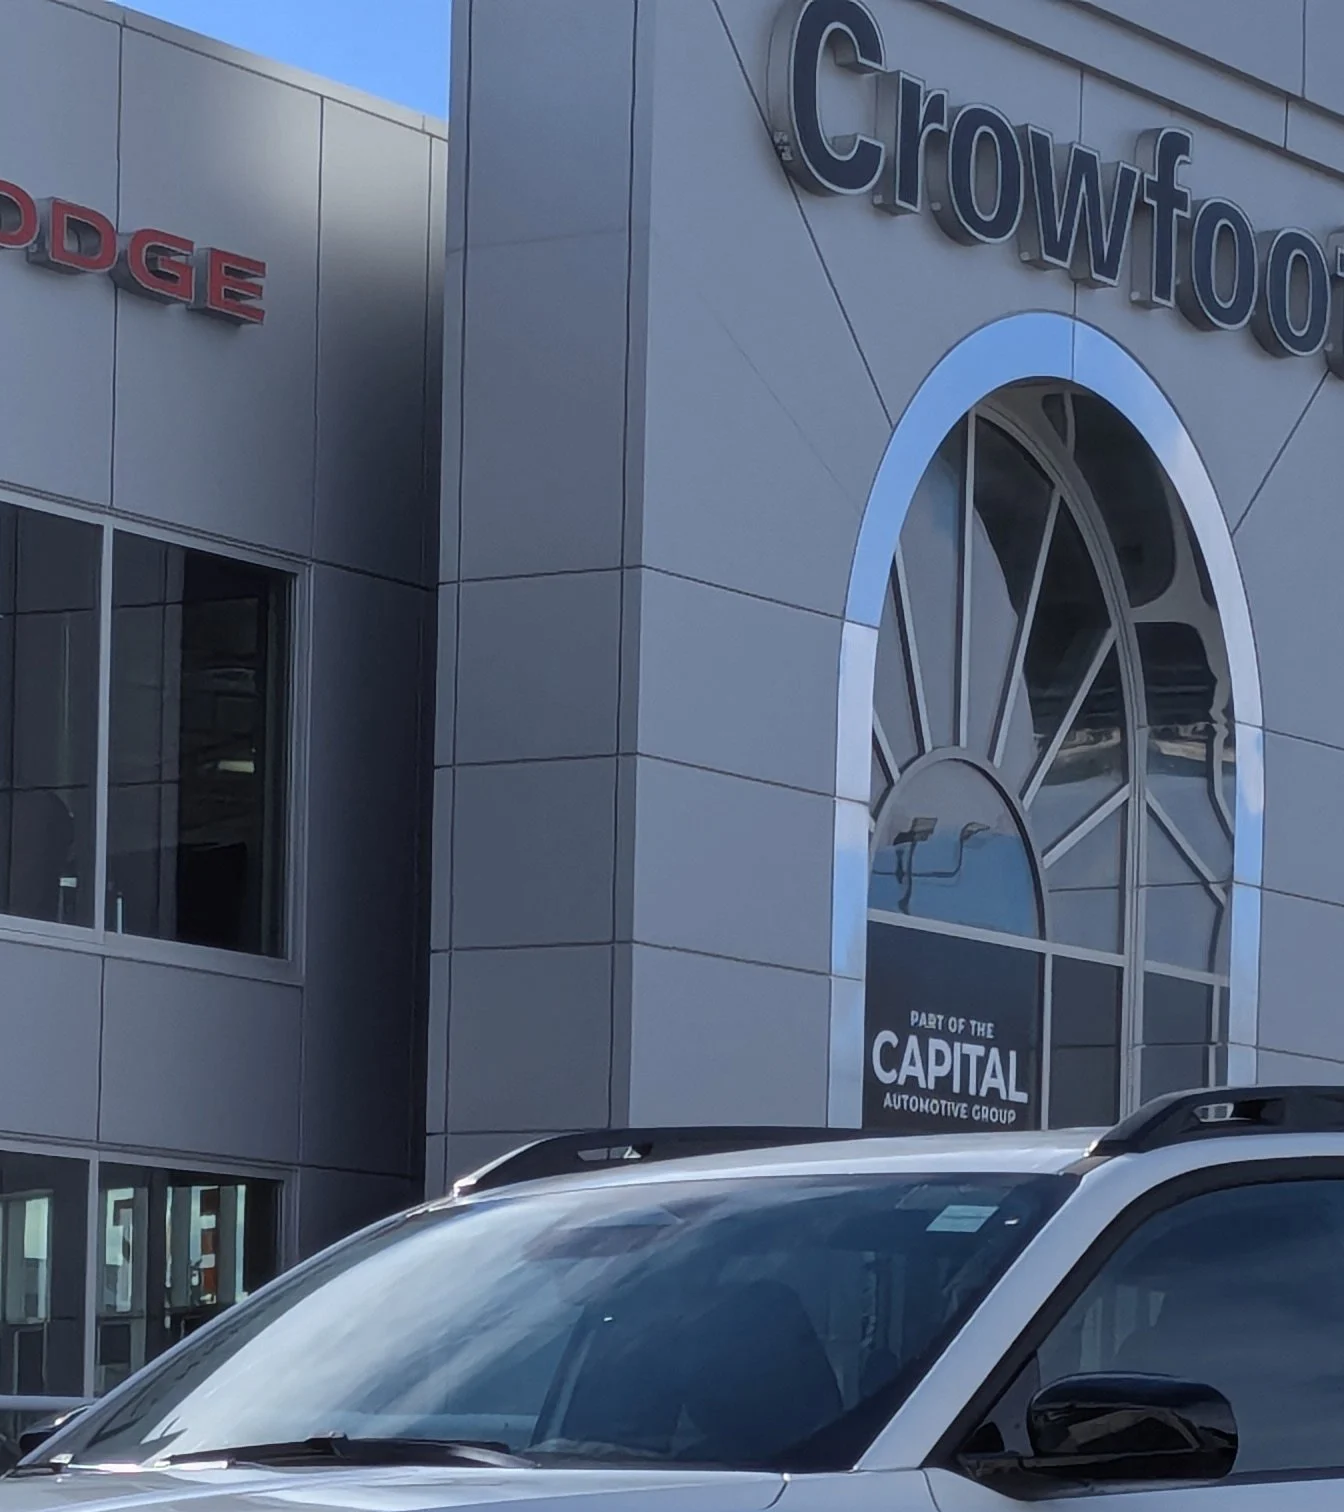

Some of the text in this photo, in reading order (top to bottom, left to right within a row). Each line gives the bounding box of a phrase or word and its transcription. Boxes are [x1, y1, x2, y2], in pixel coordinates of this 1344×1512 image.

[910, 1010, 995, 1039] PART OF THE
[872, 1029, 1029, 1104] CAPITAL
[883, 1092, 1017, 1125] AUTOMOTIVE GROUP
